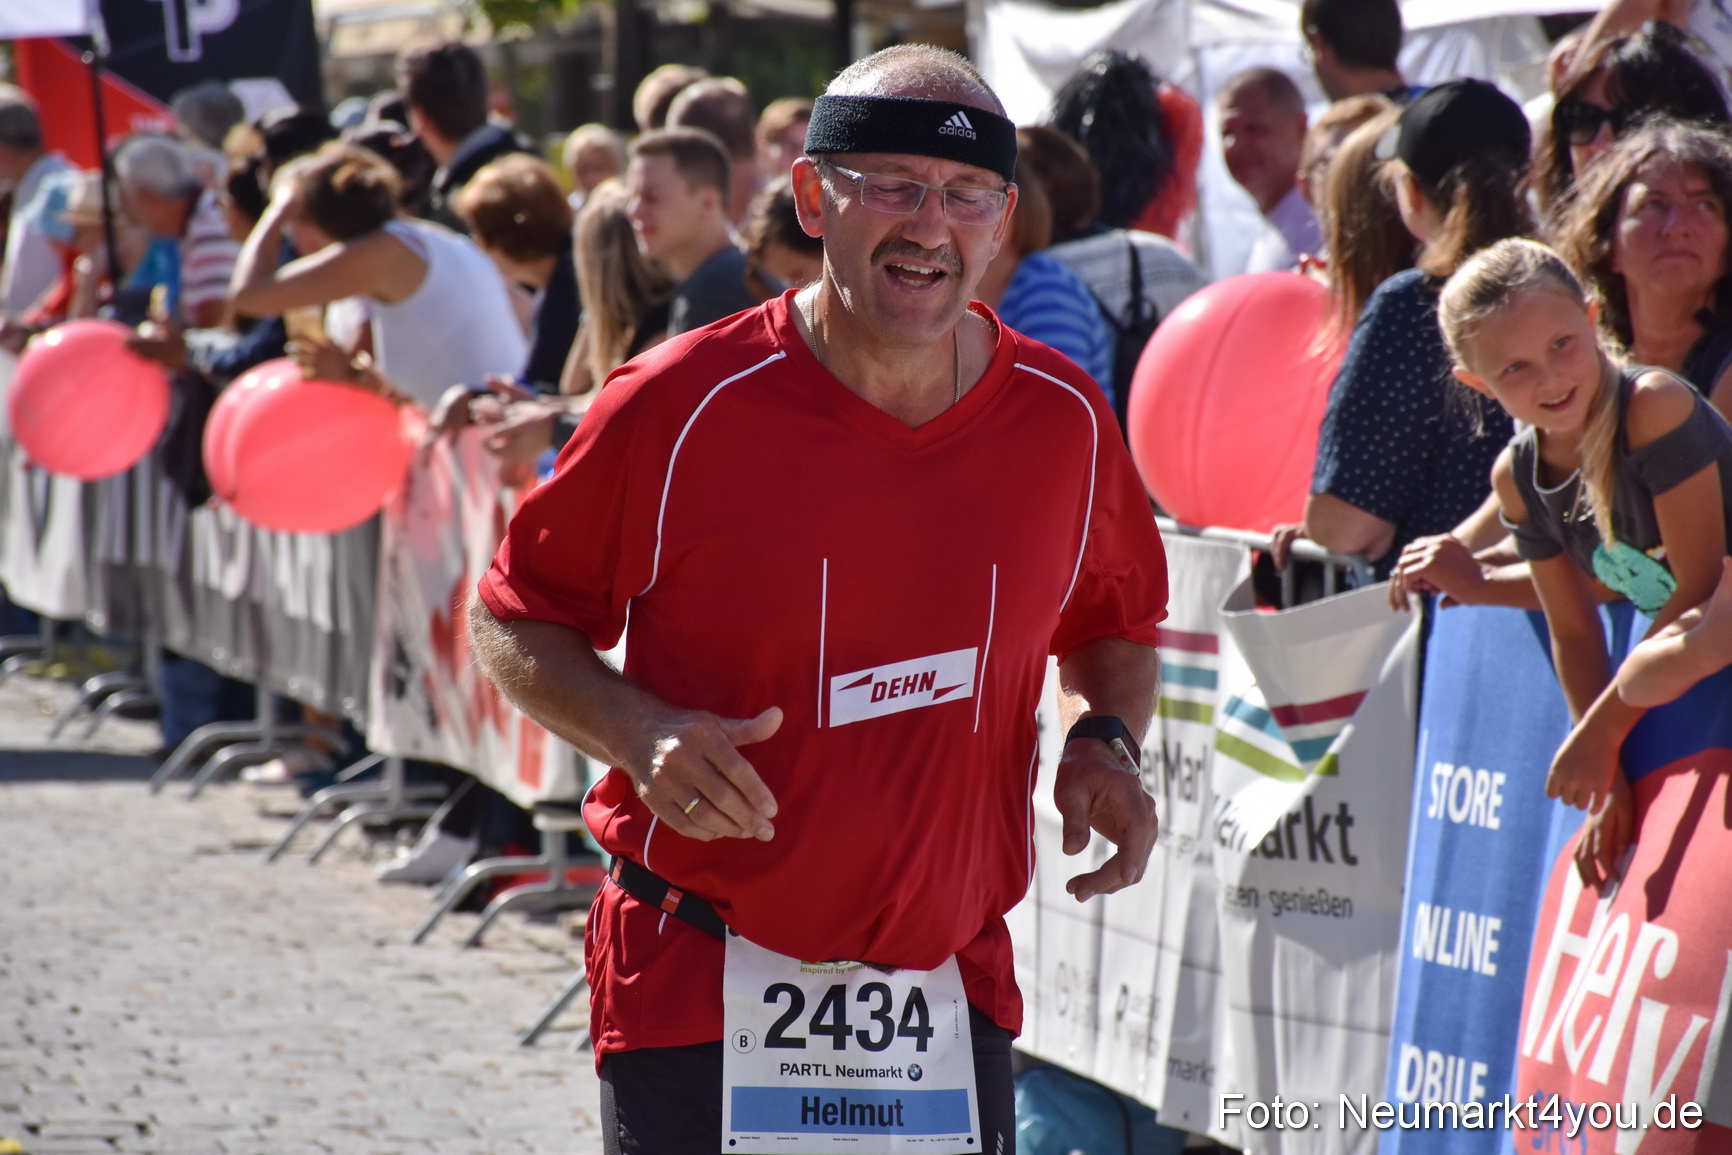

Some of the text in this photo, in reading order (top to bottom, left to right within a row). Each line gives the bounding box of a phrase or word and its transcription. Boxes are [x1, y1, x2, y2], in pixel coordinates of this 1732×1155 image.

[938, 125, 977, 141] adidas
[870, 670, 937, 703] DEHN
[1427, 761, 1506, 830] STORE
[1412, 901, 1502, 977] ONLINE
[800, 965, 833, 975] inspired
[836, 967, 846, 975] by
[763, 982, 934, 1053] 2434
[739, 1035, 749, 1048] B
[779, 1063, 903, 1079] PARTL Neumarkt
[801, 1095, 905, 1128] Helmut
